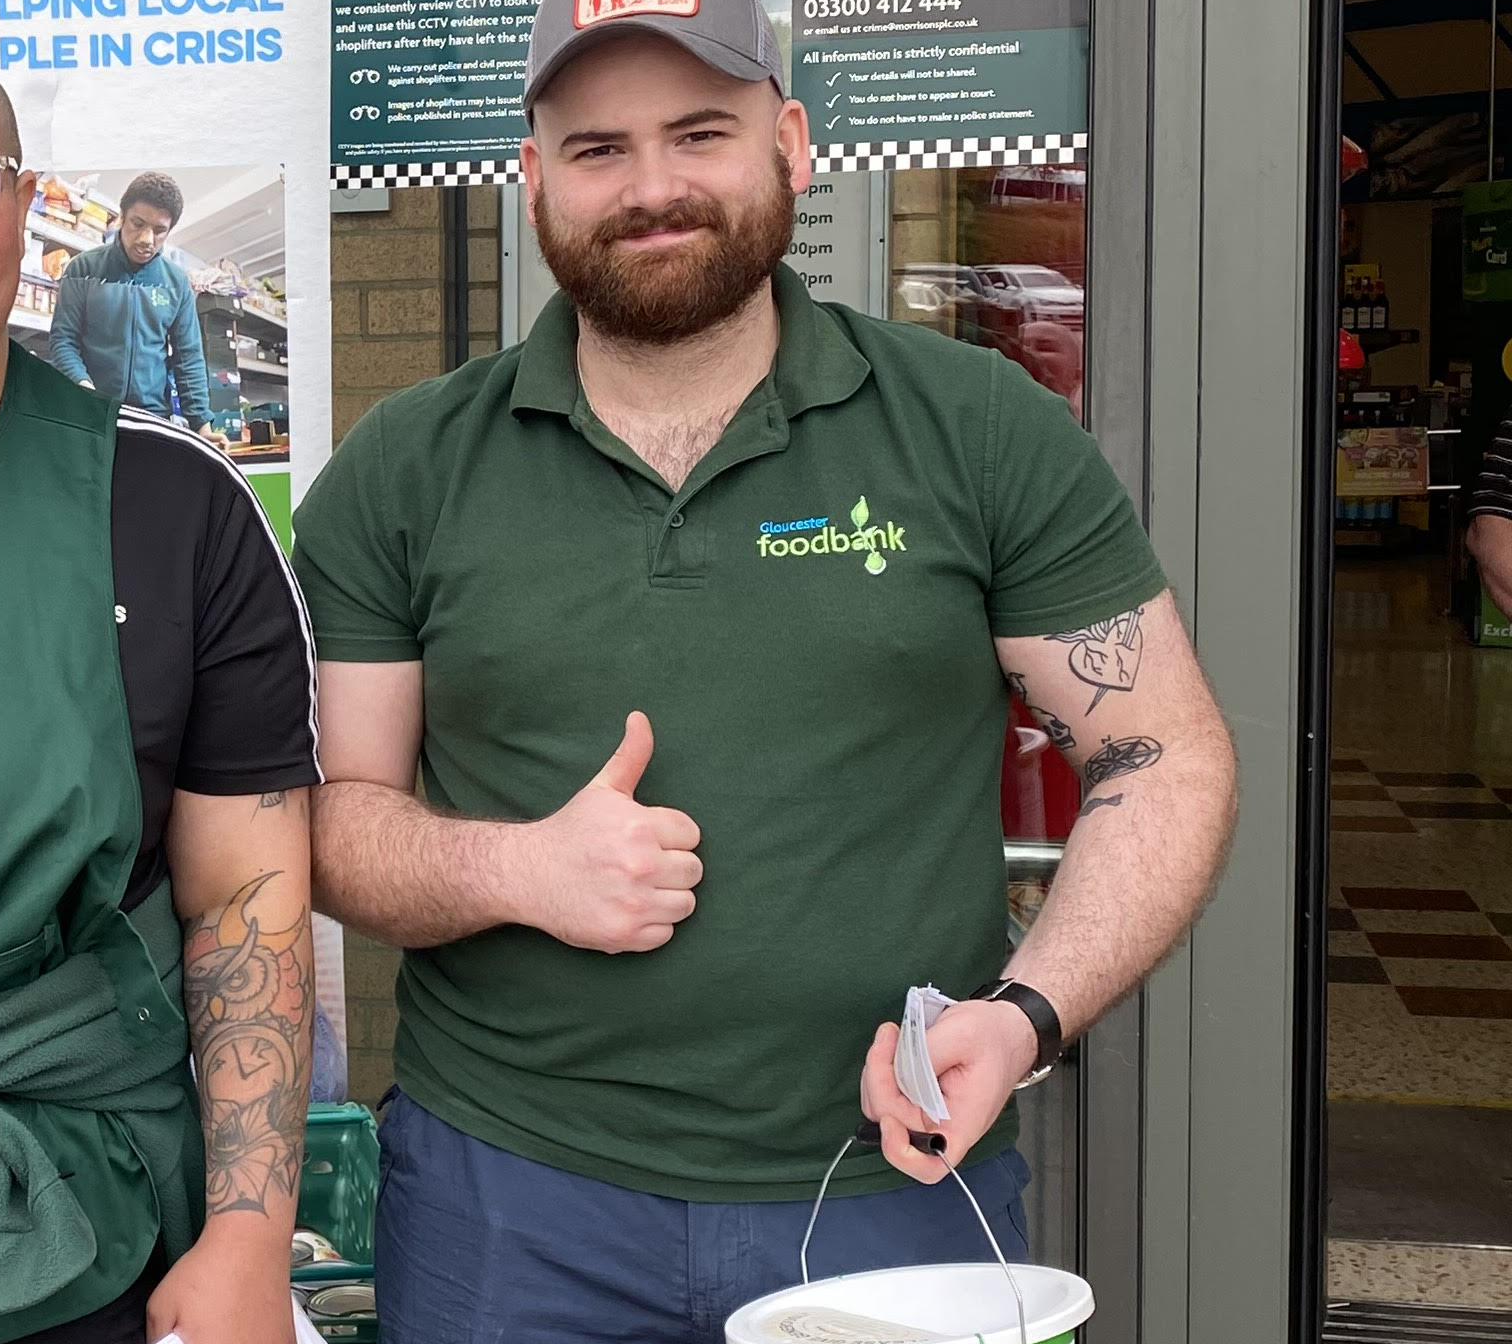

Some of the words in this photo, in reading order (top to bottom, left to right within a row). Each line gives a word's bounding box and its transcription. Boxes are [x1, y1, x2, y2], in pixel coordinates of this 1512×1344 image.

[335, 6, 352, 16] we
[353, 0, 417, 15] consistently
[418, 0, 454, 12] review
[335, 21, 356, 34] and
[357, 23, 374, 33] we
[375, 22, 394, 32] use
[395, 18, 416, 31] this
[417, 16, 449, 29] CCTV
[450, 14, 499, 28] evidence
[500, 15, 514, 25] to
[803, 28, 814, 36] or
[814, 24, 839, 35] email
[840, 26, 851, 34] us
[852, 25, 862, 34] at
[90, 33, 132, 68] IN
[144, 27, 283, 67] CRISIS
[335, 38, 392, 54] shoplifters
[394, 36, 421, 49] after
[421, 35, 447, 50] they
[448, 33, 474, 46] have
[475, 31, 496, 45] left
[497, 31, 517, 44] the
[802, 51, 820, 64] All
[821, 49, 891, 63] information
[893, 47, 903, 60] is
[904, 45, 946, 61] strictly
[948, 41, 1020, 57] confidential
[848, 73, 870, 82] Your
[870, 70, 899, 81] details
[899, 69, 916, 80] will
[916, 70, 933, 79] not
[933, 68, 946, 78] be
[946, 66, 977, 78] shared.
[387, 101, 415, 111] Images
[415, 98, 425, 109] of
[425, 97, 467, 110] shoplifters
[467, 98, 485, 108] may
[485, 96, 497, 105] be
[497, 94, 523, 105] issued
[760, 516, 828, 534] Gloucester
[756, 521, 906, 557] foodbank
